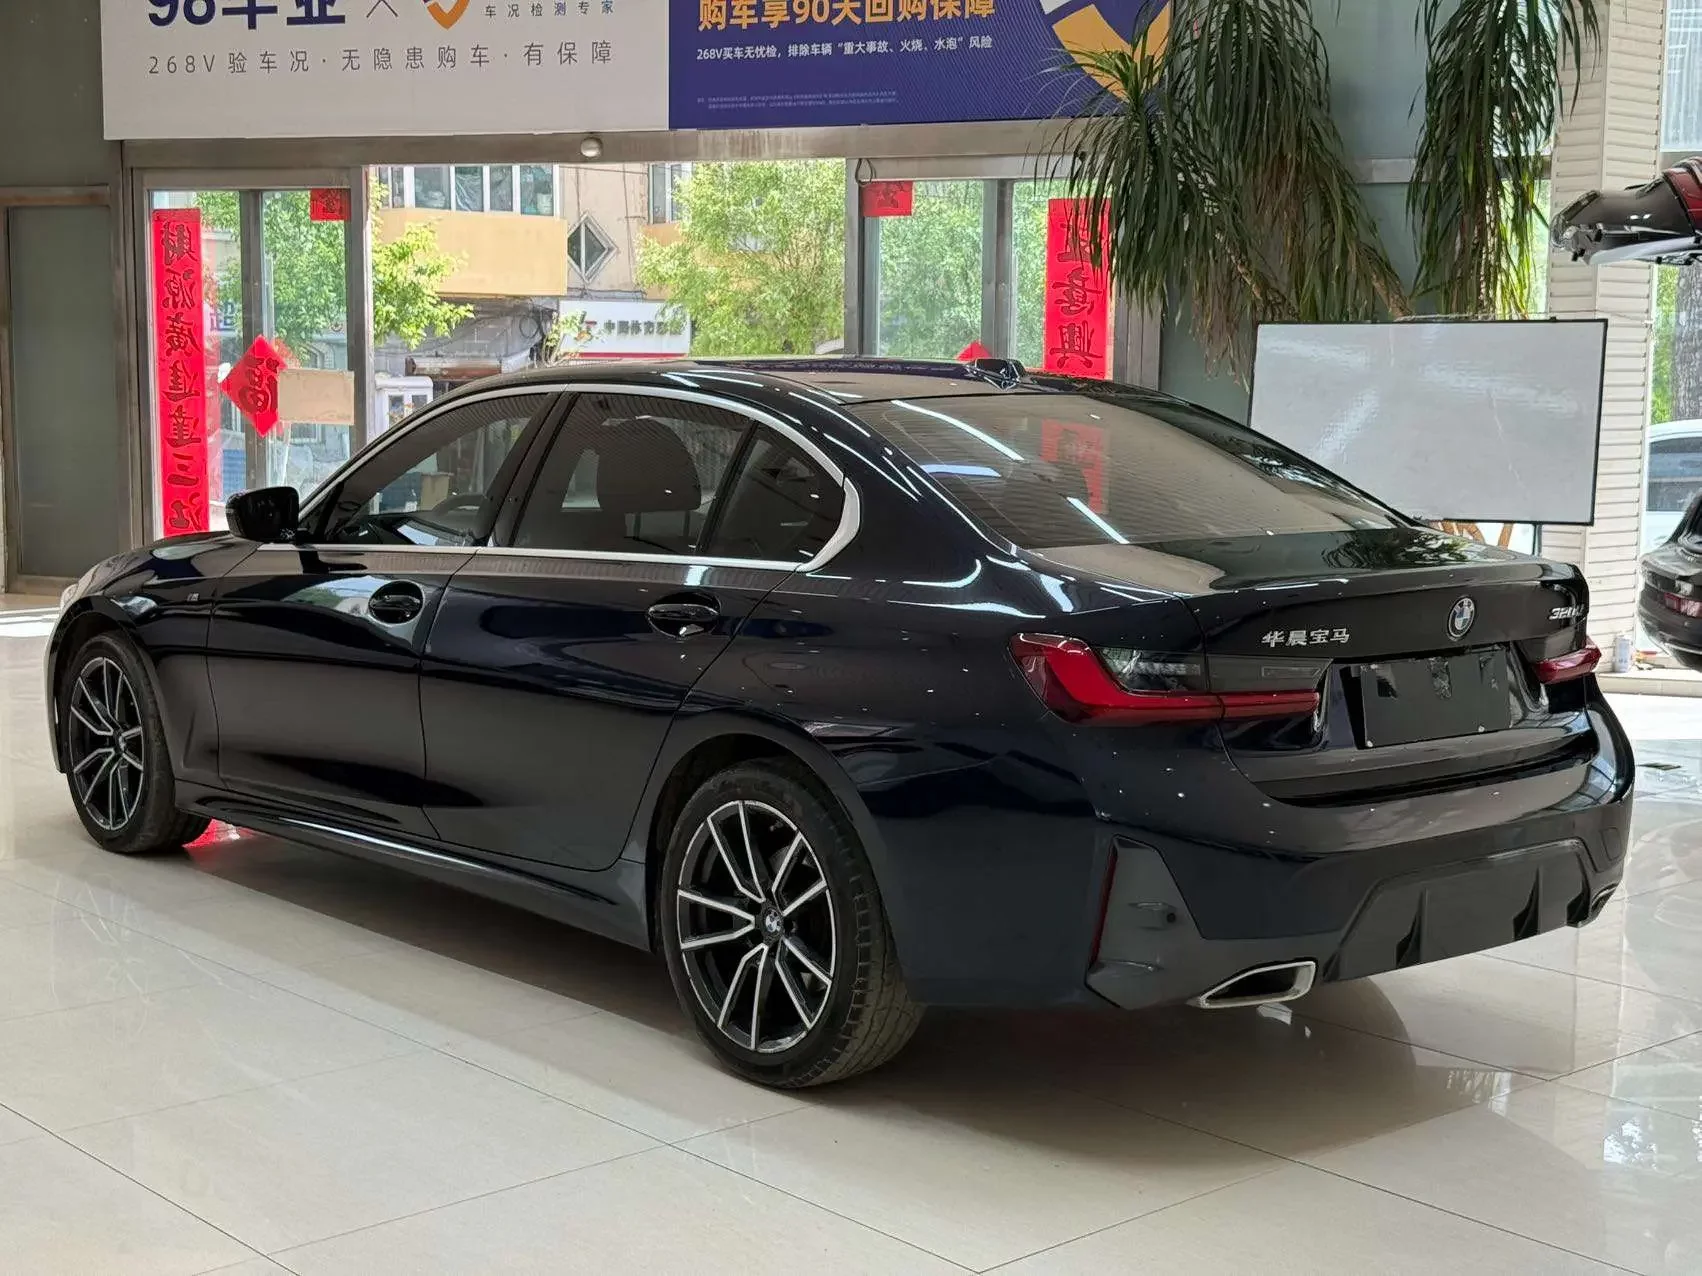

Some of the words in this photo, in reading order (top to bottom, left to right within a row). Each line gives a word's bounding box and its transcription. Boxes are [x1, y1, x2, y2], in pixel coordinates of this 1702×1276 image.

[485, 0, 614, 18] 车况检测专家
[698, 0, 995, 31] 购车享90天回购保障
[1261, 627, 1350, 648] 华晨宝马
